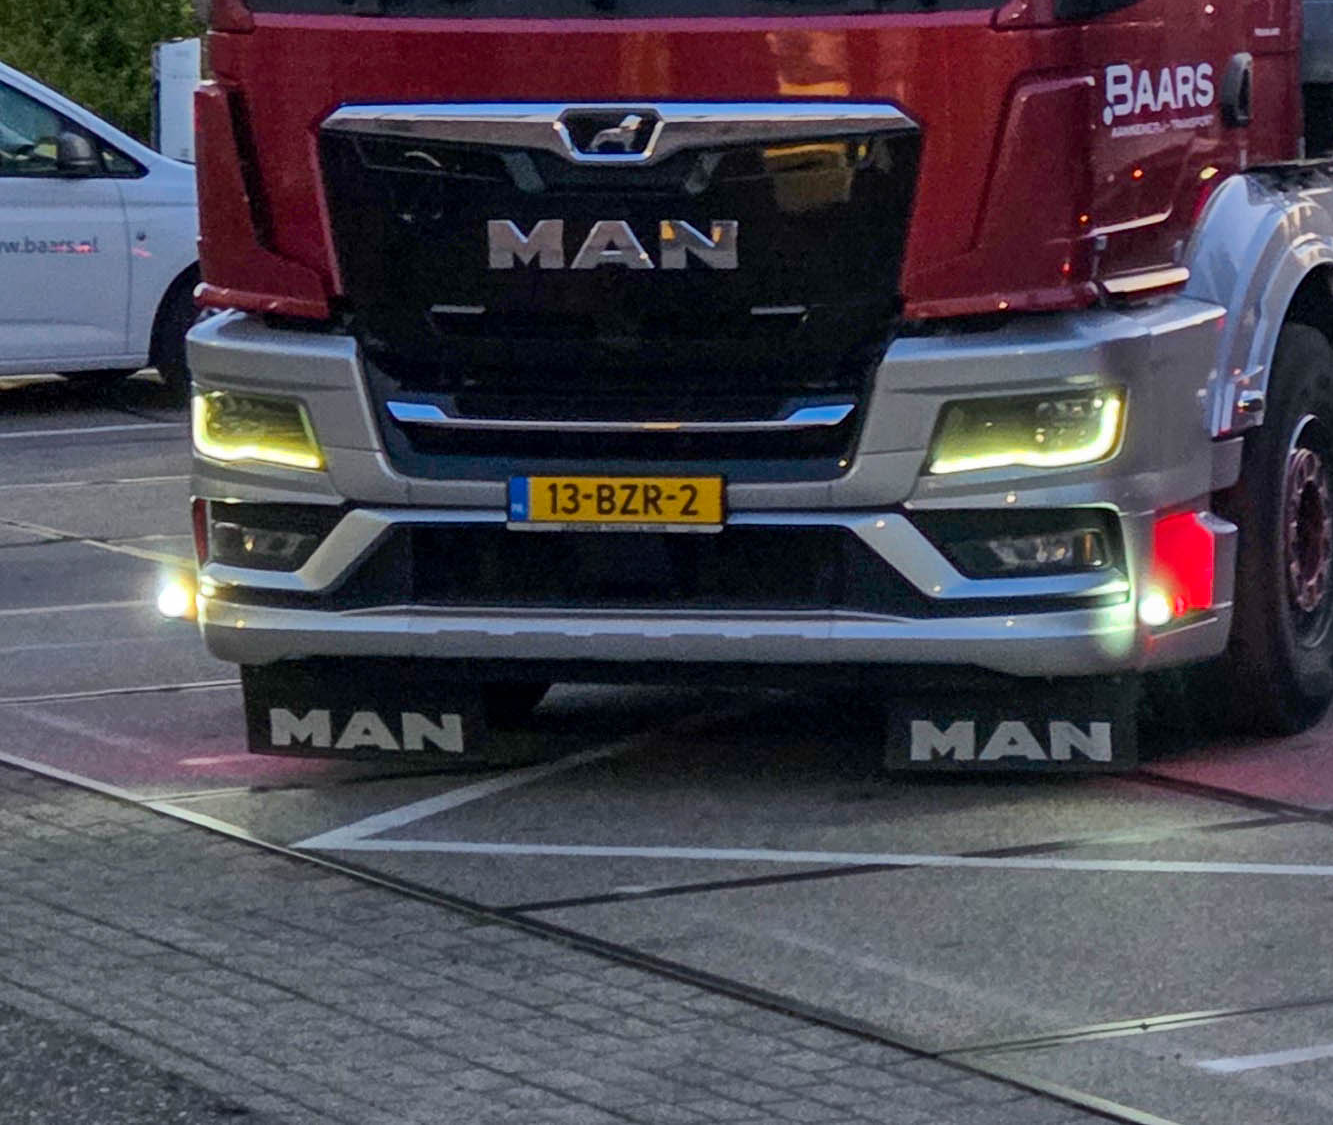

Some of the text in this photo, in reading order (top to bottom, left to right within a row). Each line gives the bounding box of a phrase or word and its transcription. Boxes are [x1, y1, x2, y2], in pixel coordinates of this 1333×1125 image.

[1104, 62, 1215, 117] BAARS
[487, 219, 739, 270] MAN
[547, 482, 700, 517] 13-BZR-2
[269, 708, 465, 753] MAN
[910, 720, 1113, 762] MAN
